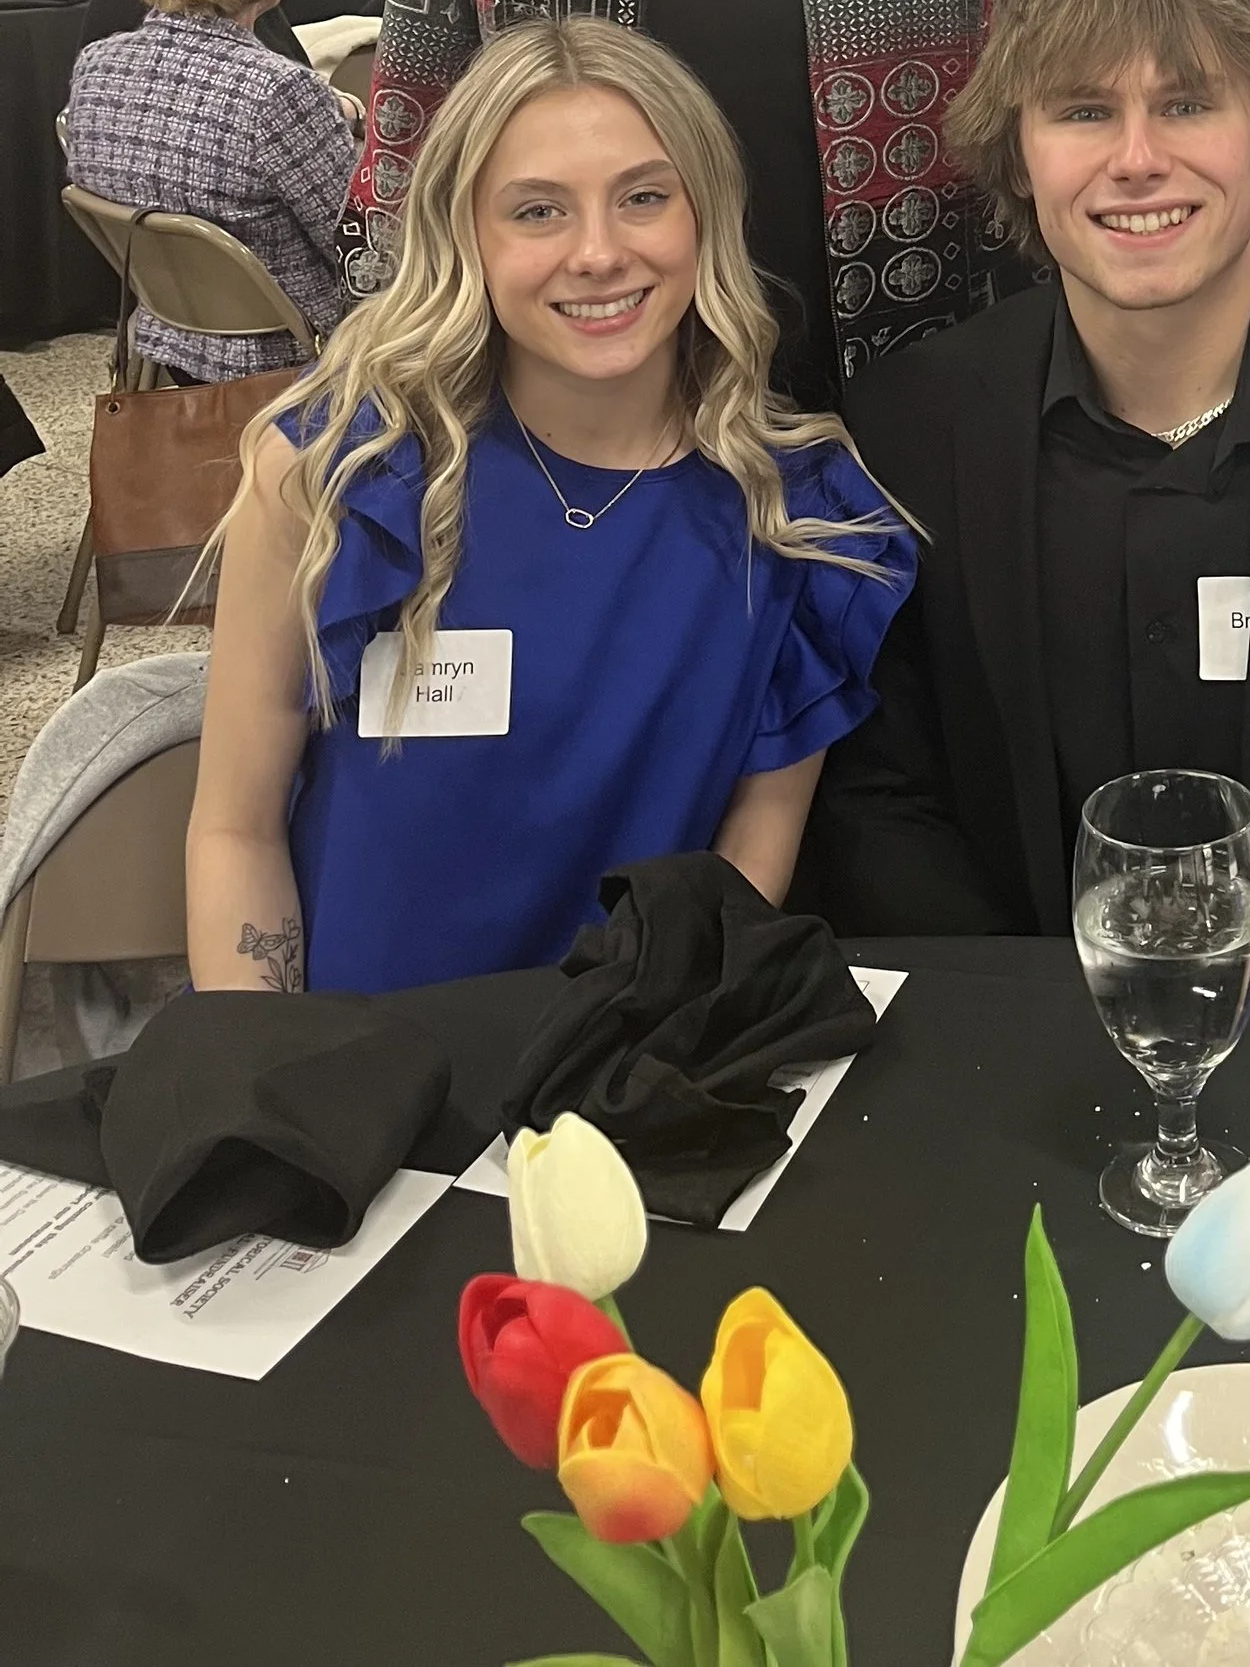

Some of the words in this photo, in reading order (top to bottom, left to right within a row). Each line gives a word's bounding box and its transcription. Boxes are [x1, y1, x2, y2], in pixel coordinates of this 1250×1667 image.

[416, 685, 453, 703] Hall
[169, 1246, 240, 1307] FUNDRAISER
[183, 1276, 232, 1319] SOCIETY
